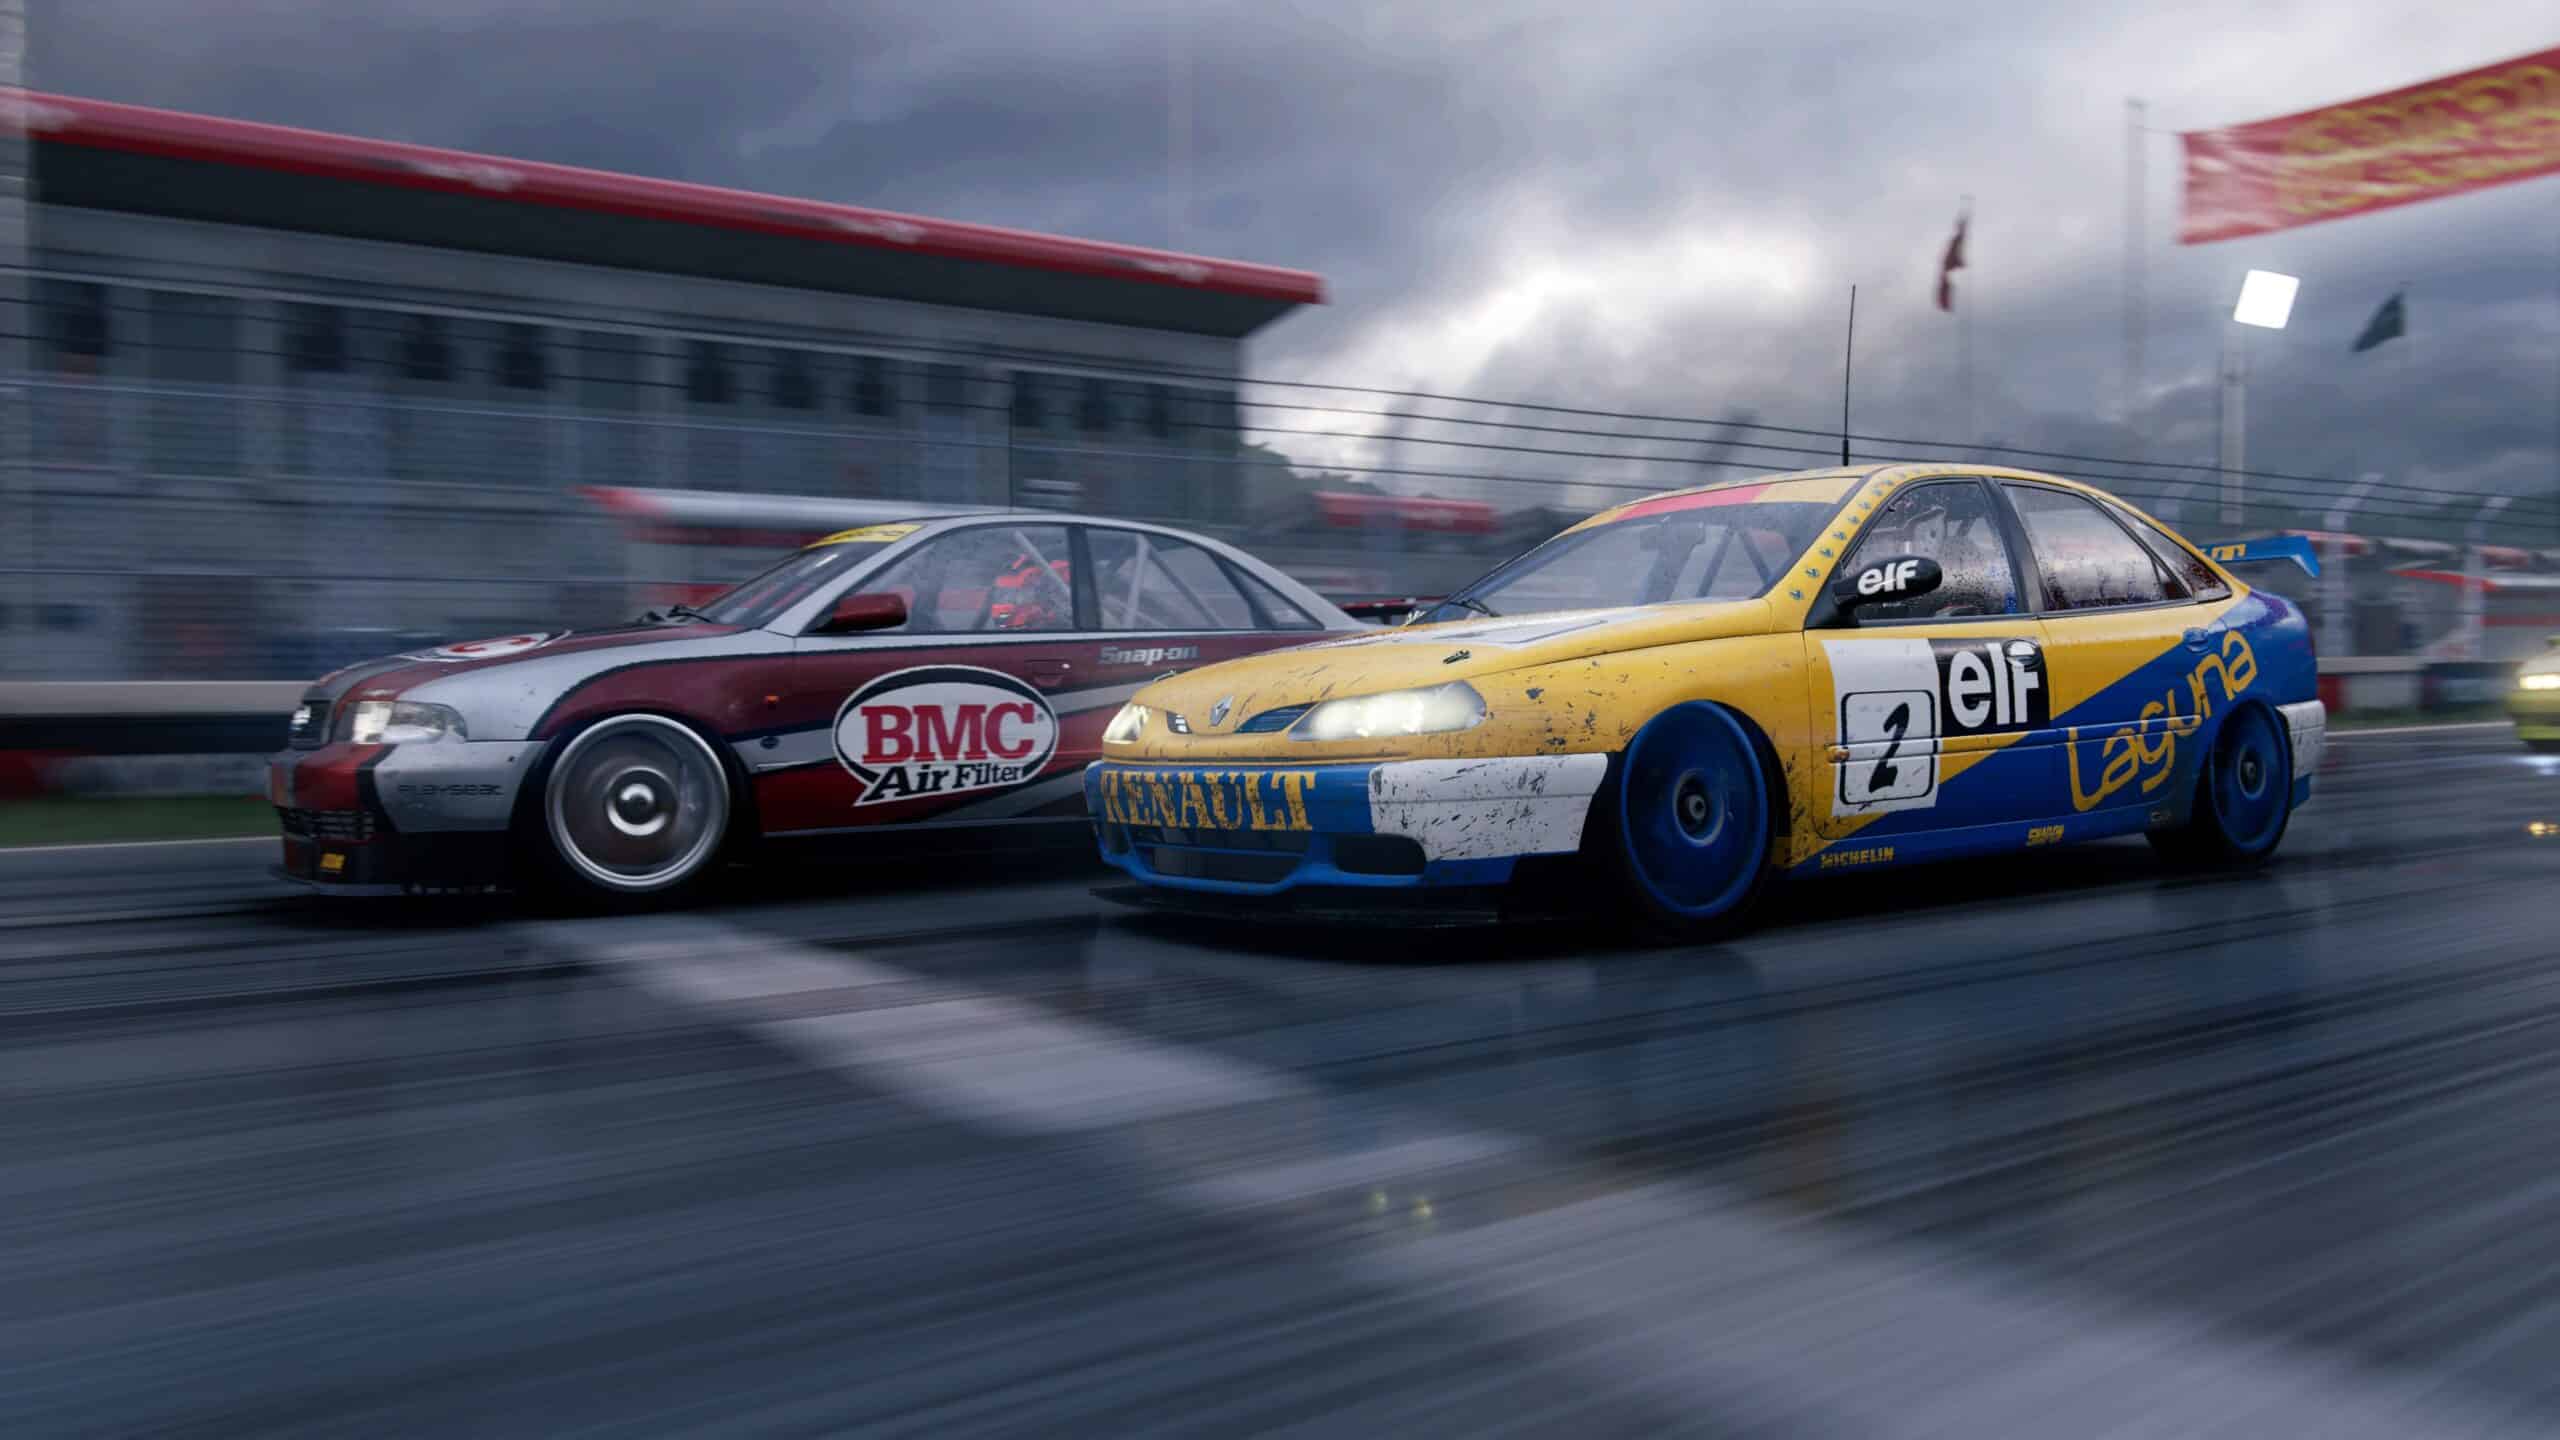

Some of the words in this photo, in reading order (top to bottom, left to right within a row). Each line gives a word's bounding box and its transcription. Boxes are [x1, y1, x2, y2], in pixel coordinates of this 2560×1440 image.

[1857, 559, 1919, 595] elf
[1099, 645, 1199, 666] Snap-on
[1948, 642, 2040, 729] elf
[860, 701, 1036, 765] BMC
[1868, 702, 1910, 793] 2
[2067, 629, 2257, 812] Laguna
[862, 764, 950, 802] Air
[951, 762, 1026, 789] Filter
[1101, 770, 1316, 831] RENAULT
[1819, 847, 1895, 869] MICHELIN
